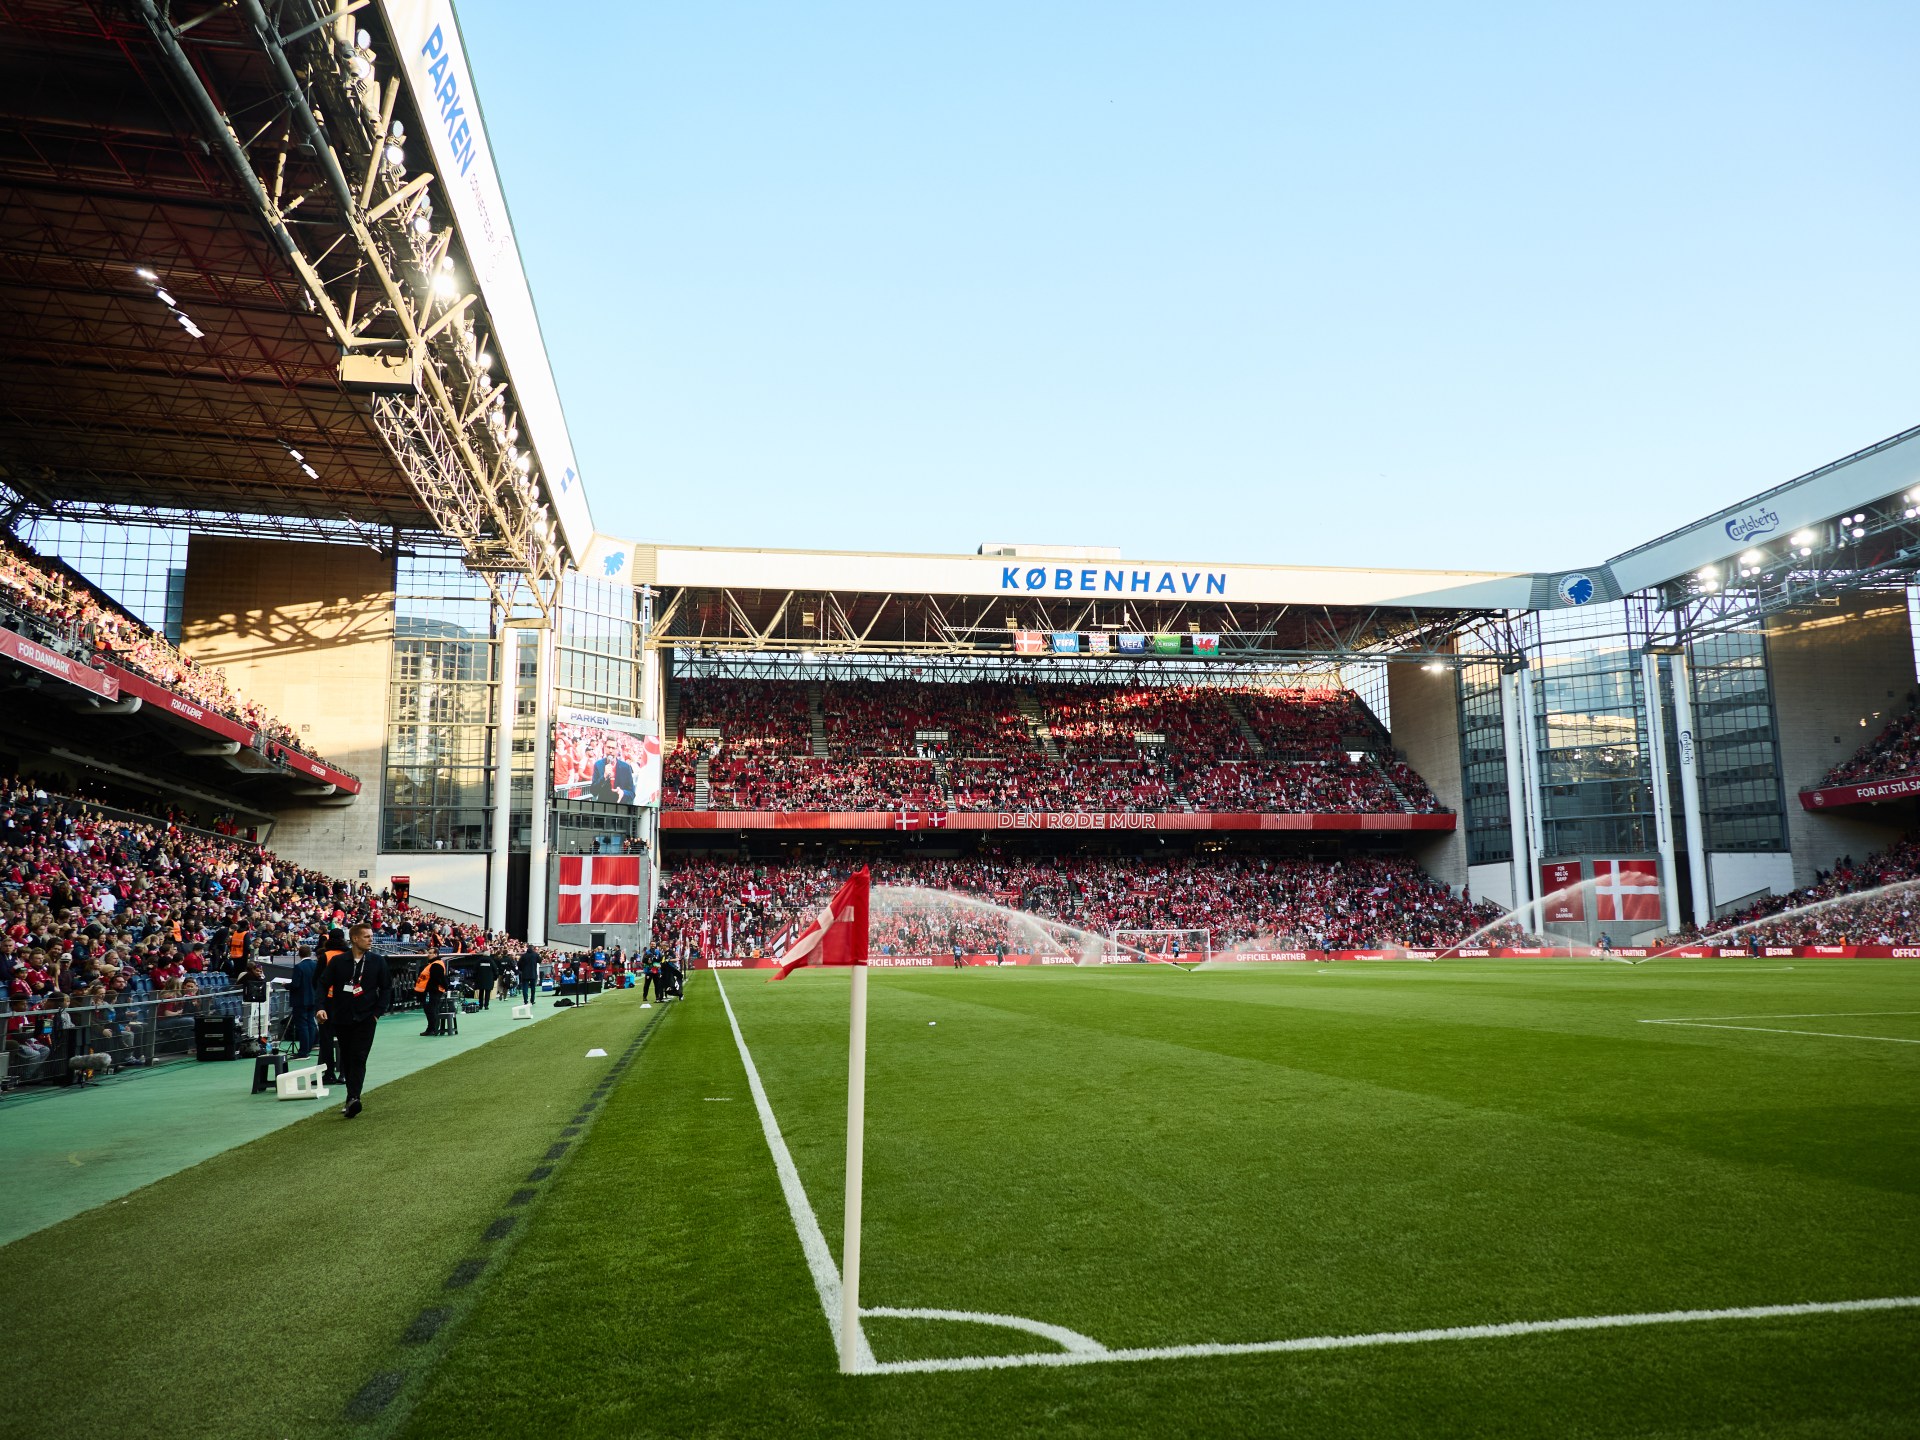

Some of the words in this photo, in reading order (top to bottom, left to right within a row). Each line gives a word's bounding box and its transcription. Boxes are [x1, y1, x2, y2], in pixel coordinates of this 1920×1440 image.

[421, 23, 476, 178] PARKEN
[1725, 508, 1780, 542] Carlsberg
[1001, 566, 1227, 595] KØBENHAVN
[1055, 639, 1075, 647] FIFA
[1121, 640, 1143, 649] UEFA
[18, 642, 34, 660] FOR
[35, 649, 70, 675] DANMARK
[171, 698, 182, 710] FOR
[181, 702, 188, 713] AT
[570, 712, 609, 726] PARKEN
[1680, 730, 1694, 765] Carlsberg
[1857, 788, 1877, 798] FOR
[1878, 785, 1889, 795] AT
[1890, 780, 1910, 794] STÅ
[998, 813, 1041, 829] DEN
[1047, 812, 1106, 830] RØDE
[1110, 813, 1156, 829] MUR
[1236, 953, 1271, 961] OFFICIEL
[1271, 952, 1307, 961] PARTNER
[1414, 951, 1437, 959] STARK
[1466, 949, 1489, 957] STARK
[1622, 949, 1647, 957] PARTNER
[1725, 949, 1746, 957] STARK
[1772, 948, 1794, 956] STARK
[895, 957, 933, 967] PARTNER
[1050, 956, 1075, 964] STARK
